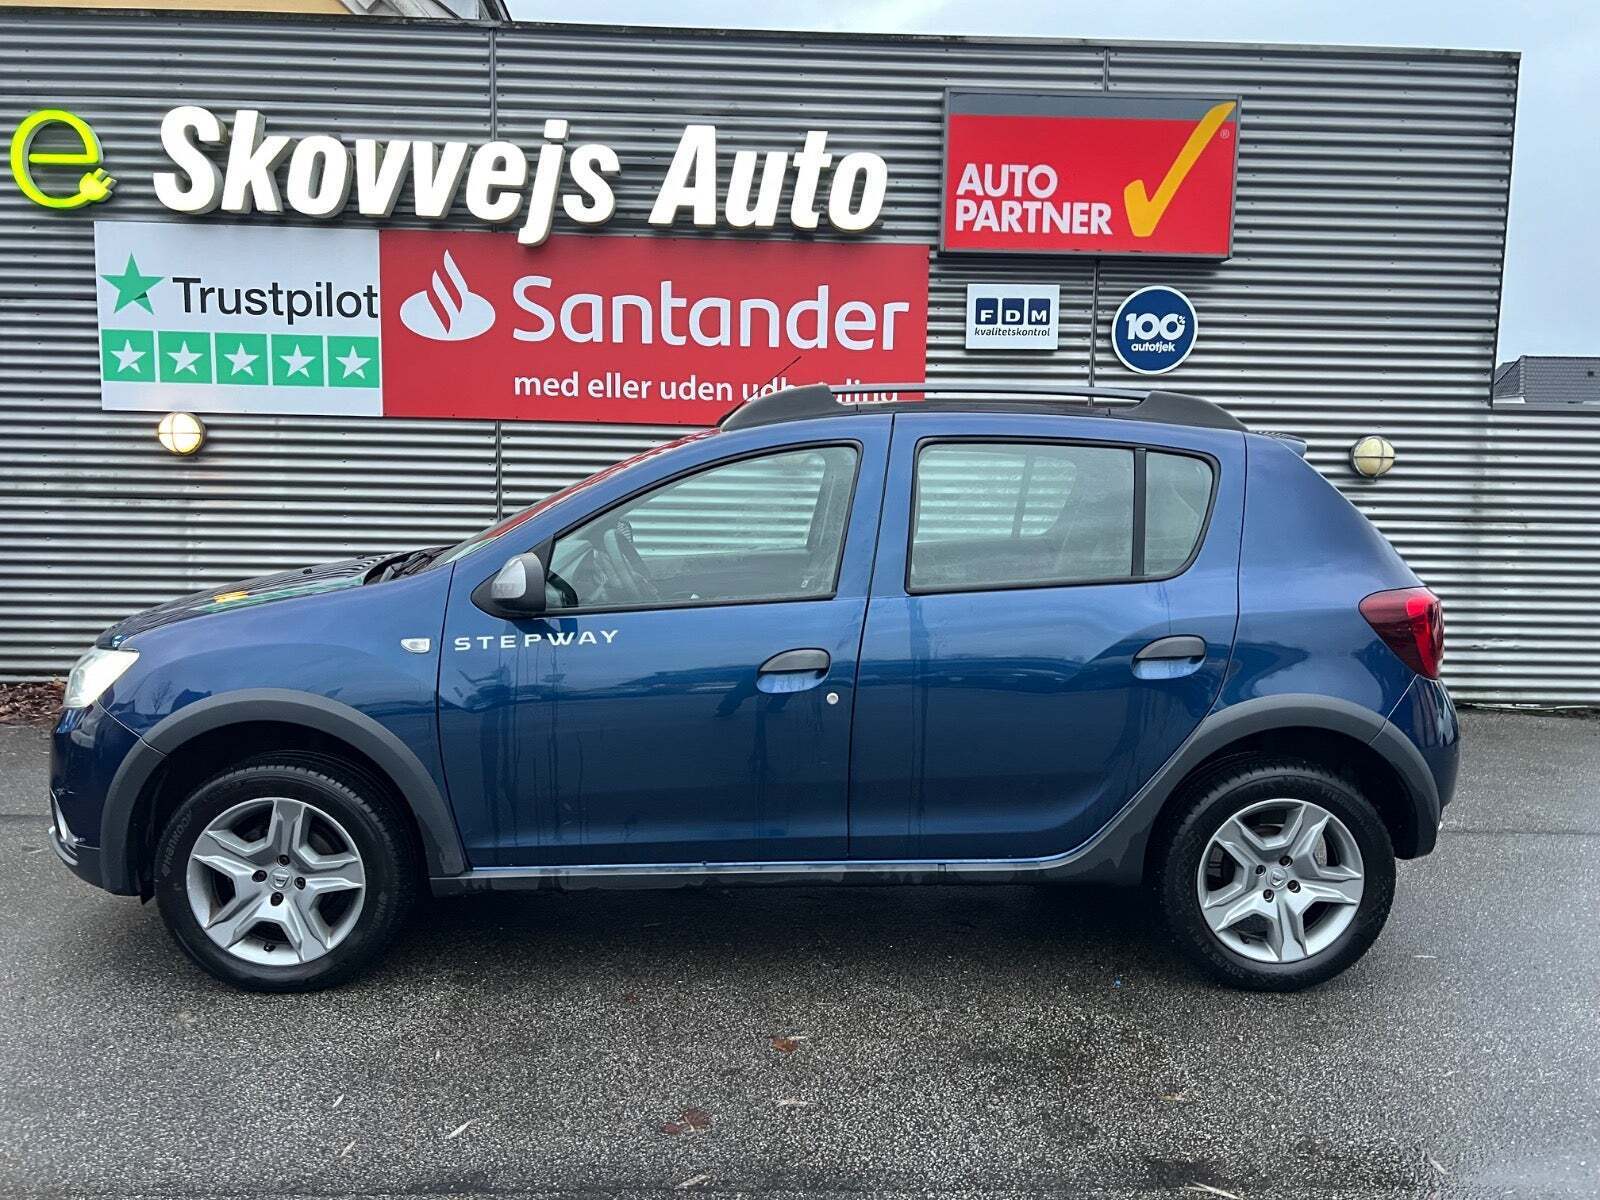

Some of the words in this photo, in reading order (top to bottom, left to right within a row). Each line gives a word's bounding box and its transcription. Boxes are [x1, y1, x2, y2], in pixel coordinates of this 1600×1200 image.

[153, 105, 621, 246] Skovvejs
[647, 124, 889, 233] Auto
[955, 162, 1059, 199] AUTO
[954, 199, 1113, 236] PARTNER
[172, 276, 379, 325] Trustpilot
[512, 274, 910, 351] Santander
[974, 327, 1051, 337] kvalitetskontrol
[513, 371, 579, 397] med
[587, 372, 653, 400] eller
[659, 374, 733, 402] uden
[453, 629, 619, 651] STEPWAY
